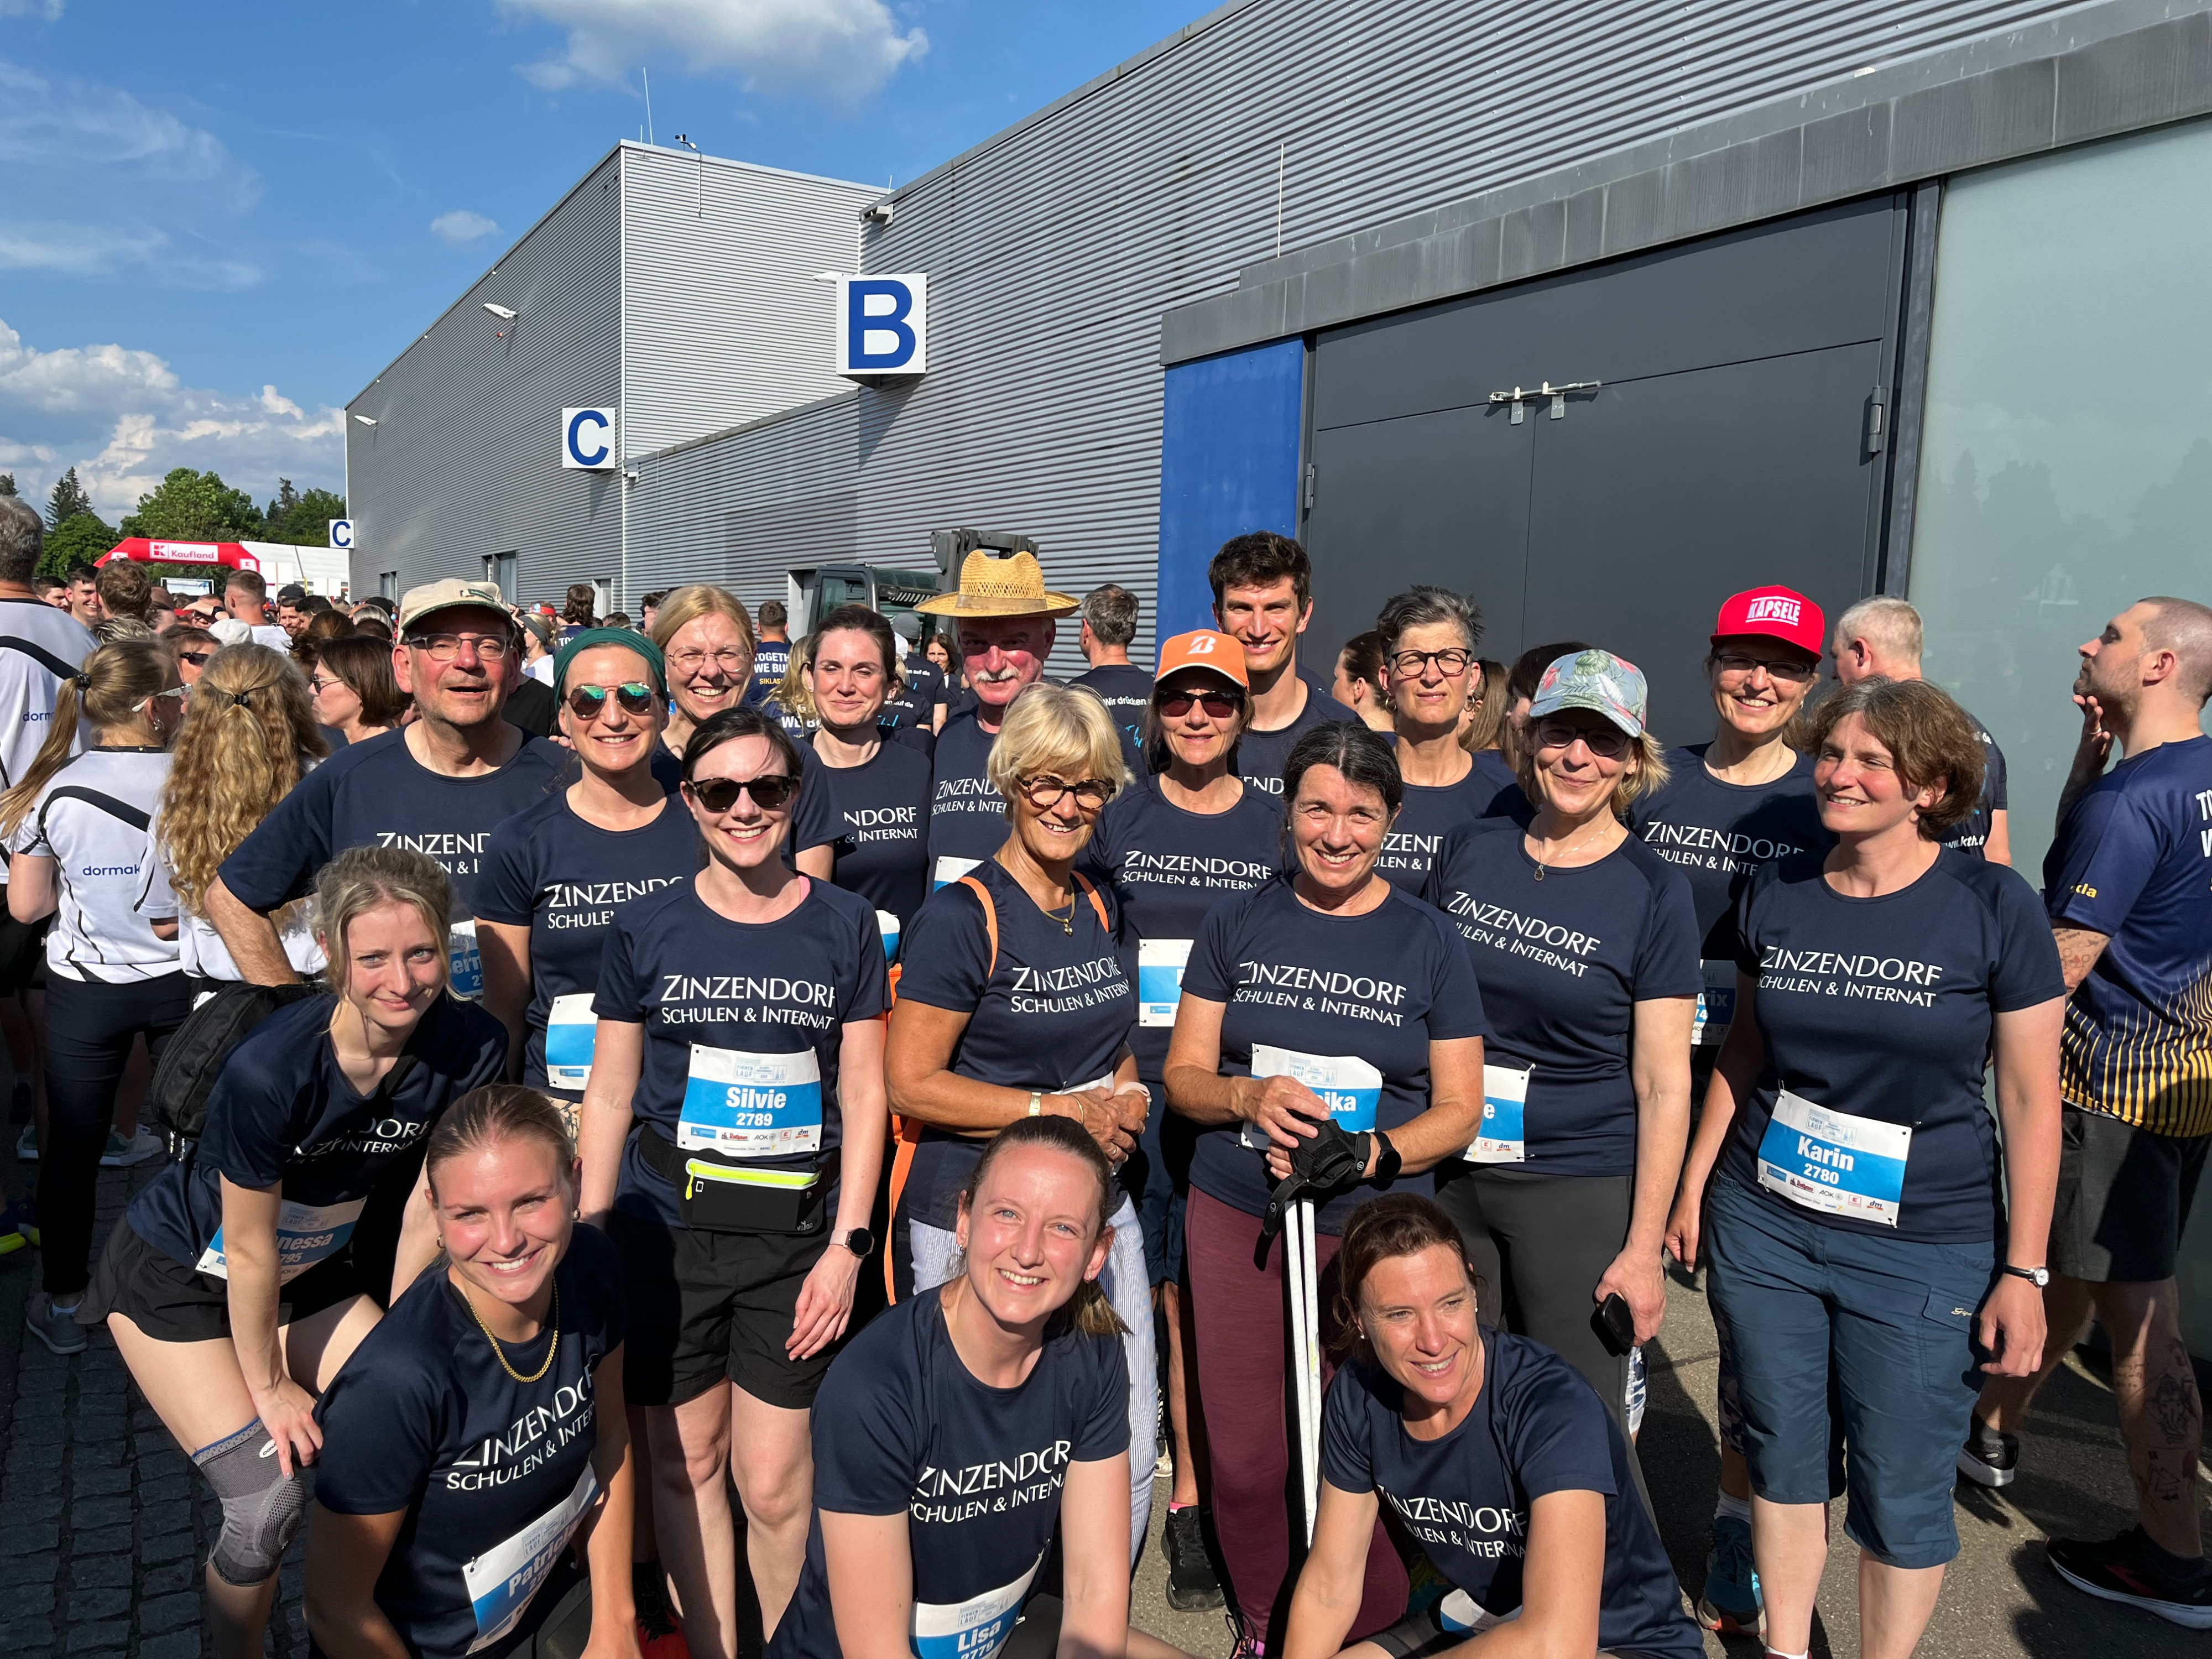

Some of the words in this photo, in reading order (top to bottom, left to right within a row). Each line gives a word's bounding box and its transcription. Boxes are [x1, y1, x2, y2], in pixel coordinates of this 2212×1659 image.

[848, 280, 916, 369] B
[568, 410, 609, 466] C
[332, 521, 351, 547] C
[171, 549, 215, 559] Kaufland
[754, 652, 790, 662] OGETH
[754, 663, 770, 673] WE
[1102, 697, 1116, 706] Wir
[1117, 696, 1147, 706] drücken
[844, 806, 917, 827] NDORF
[932, 800, 965, 817] SCHULEN
[967, 802, 976, 812] &
[859, 828, 919, 843] INTERNAT
[82, 864, 140, 876] dormak
[1125, 850, 1272, 880] ZINZENDORF
[1411, 858, 1422, 870] &
[1706, 856, 1717, 870] &
[1121, 871, 1186, 885] SCHULEN
[1190, 877, 1201, 886] &
[1447, 891, 1601, 956] ZINZENDORF
[1495, 937, 1507, 950] &
[1510, 939, 1589, 978] INTERNAT
[1760, 945, 1943, 987] ZINZENDORF
[1011, 956, 1122, 992] ZINZENDORF
[1238, 961, 1407, 1006] ZINZENDORF
[660, 974, 836, 1008] ZINZENDORF
[1756, 973, 1822, 994] SCHULEN
[1826, 982, 1838, 996] &
[1844, 981, 1937, 1008] INTERNAT
[1011, 994, 1084, 1013] SCHULEN
[1086, 992, 1094, 1006] &
[1233, 988, 1298, 1008] SCHULEN
[1303, 997, 1316, 1011] &
[1321, 997, 1404, 1027] INTERNAT
[662, 1007, 739, 1024] SCHULEN
[744, 1007, 757, 1022] &
[763, 1006, 835, 1030] INTERNAT
[726, 1087, 787, 1109] Silvie
[736, 1113, 773, 1126] 2789
[1807, 1120, 1822, 1131] LAUF
[1797, 1135, 1854, 1172] Karin
[1803, 1162, 1840, 1185] 2780
[1819, 1190, 1834, 1199] AOK
[276, 1233, 334, 1251] nessa
[281, 1252, 303, 1264] 795
[446, 1448, 543, 1490] SCHULEN
[546, 1439, 557, 1458] &
[916, 1440, 1071, 1498] ZINZENDOR
[993, 1497, 1007, 1512] &
[525, 1537, 541, 1555] LAUF
[1451, 1531, 1464, 1547] &
[1464, 1531, 1526, 1558] INTERNA
[509, 1519, 579, 1598] Patricia
[960, 1615, 977, 1625] LAUF
[958, 1620, 1001, 1652] Lisa
